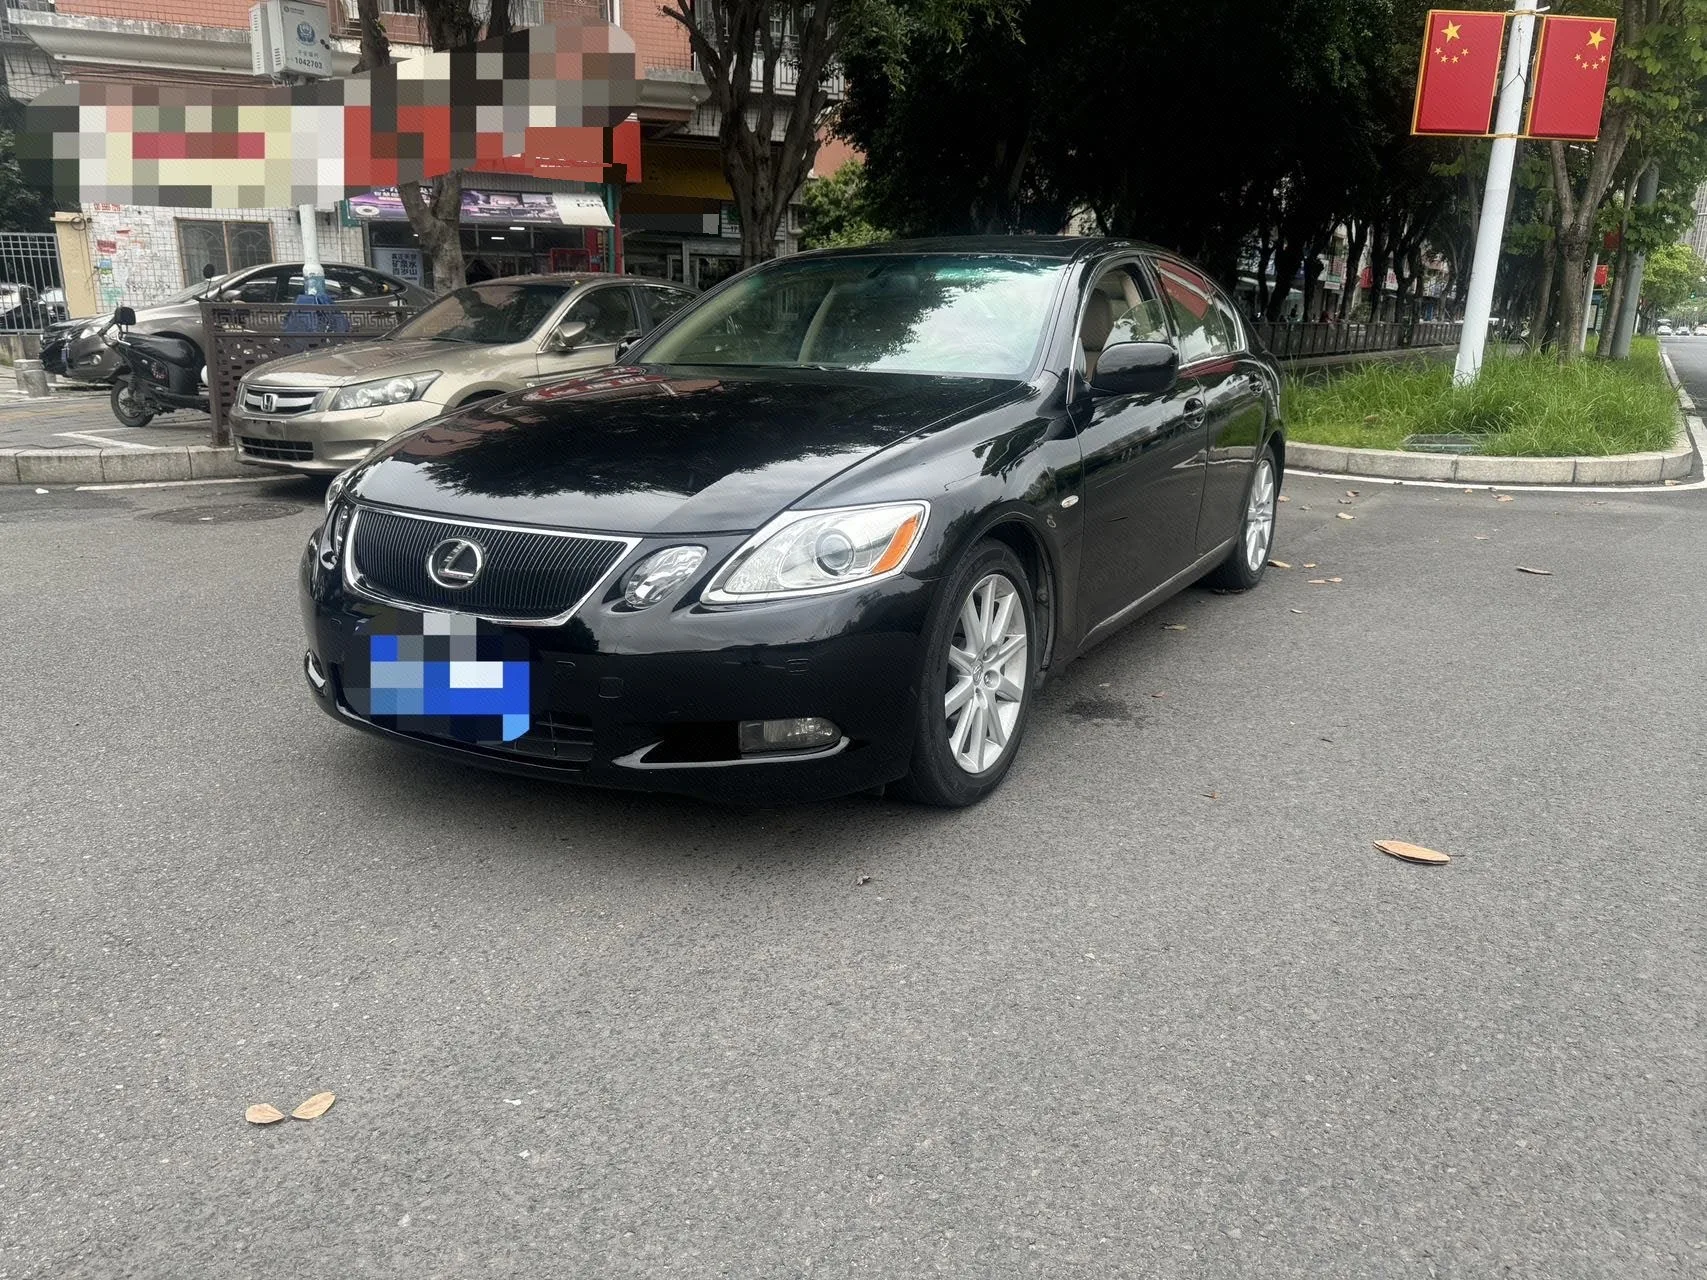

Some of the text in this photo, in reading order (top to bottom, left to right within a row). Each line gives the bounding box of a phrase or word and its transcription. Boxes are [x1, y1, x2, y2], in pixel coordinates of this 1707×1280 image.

[295, 57, 323, 69] 1042703
[391, 259, 417, 269] 矿泉水
